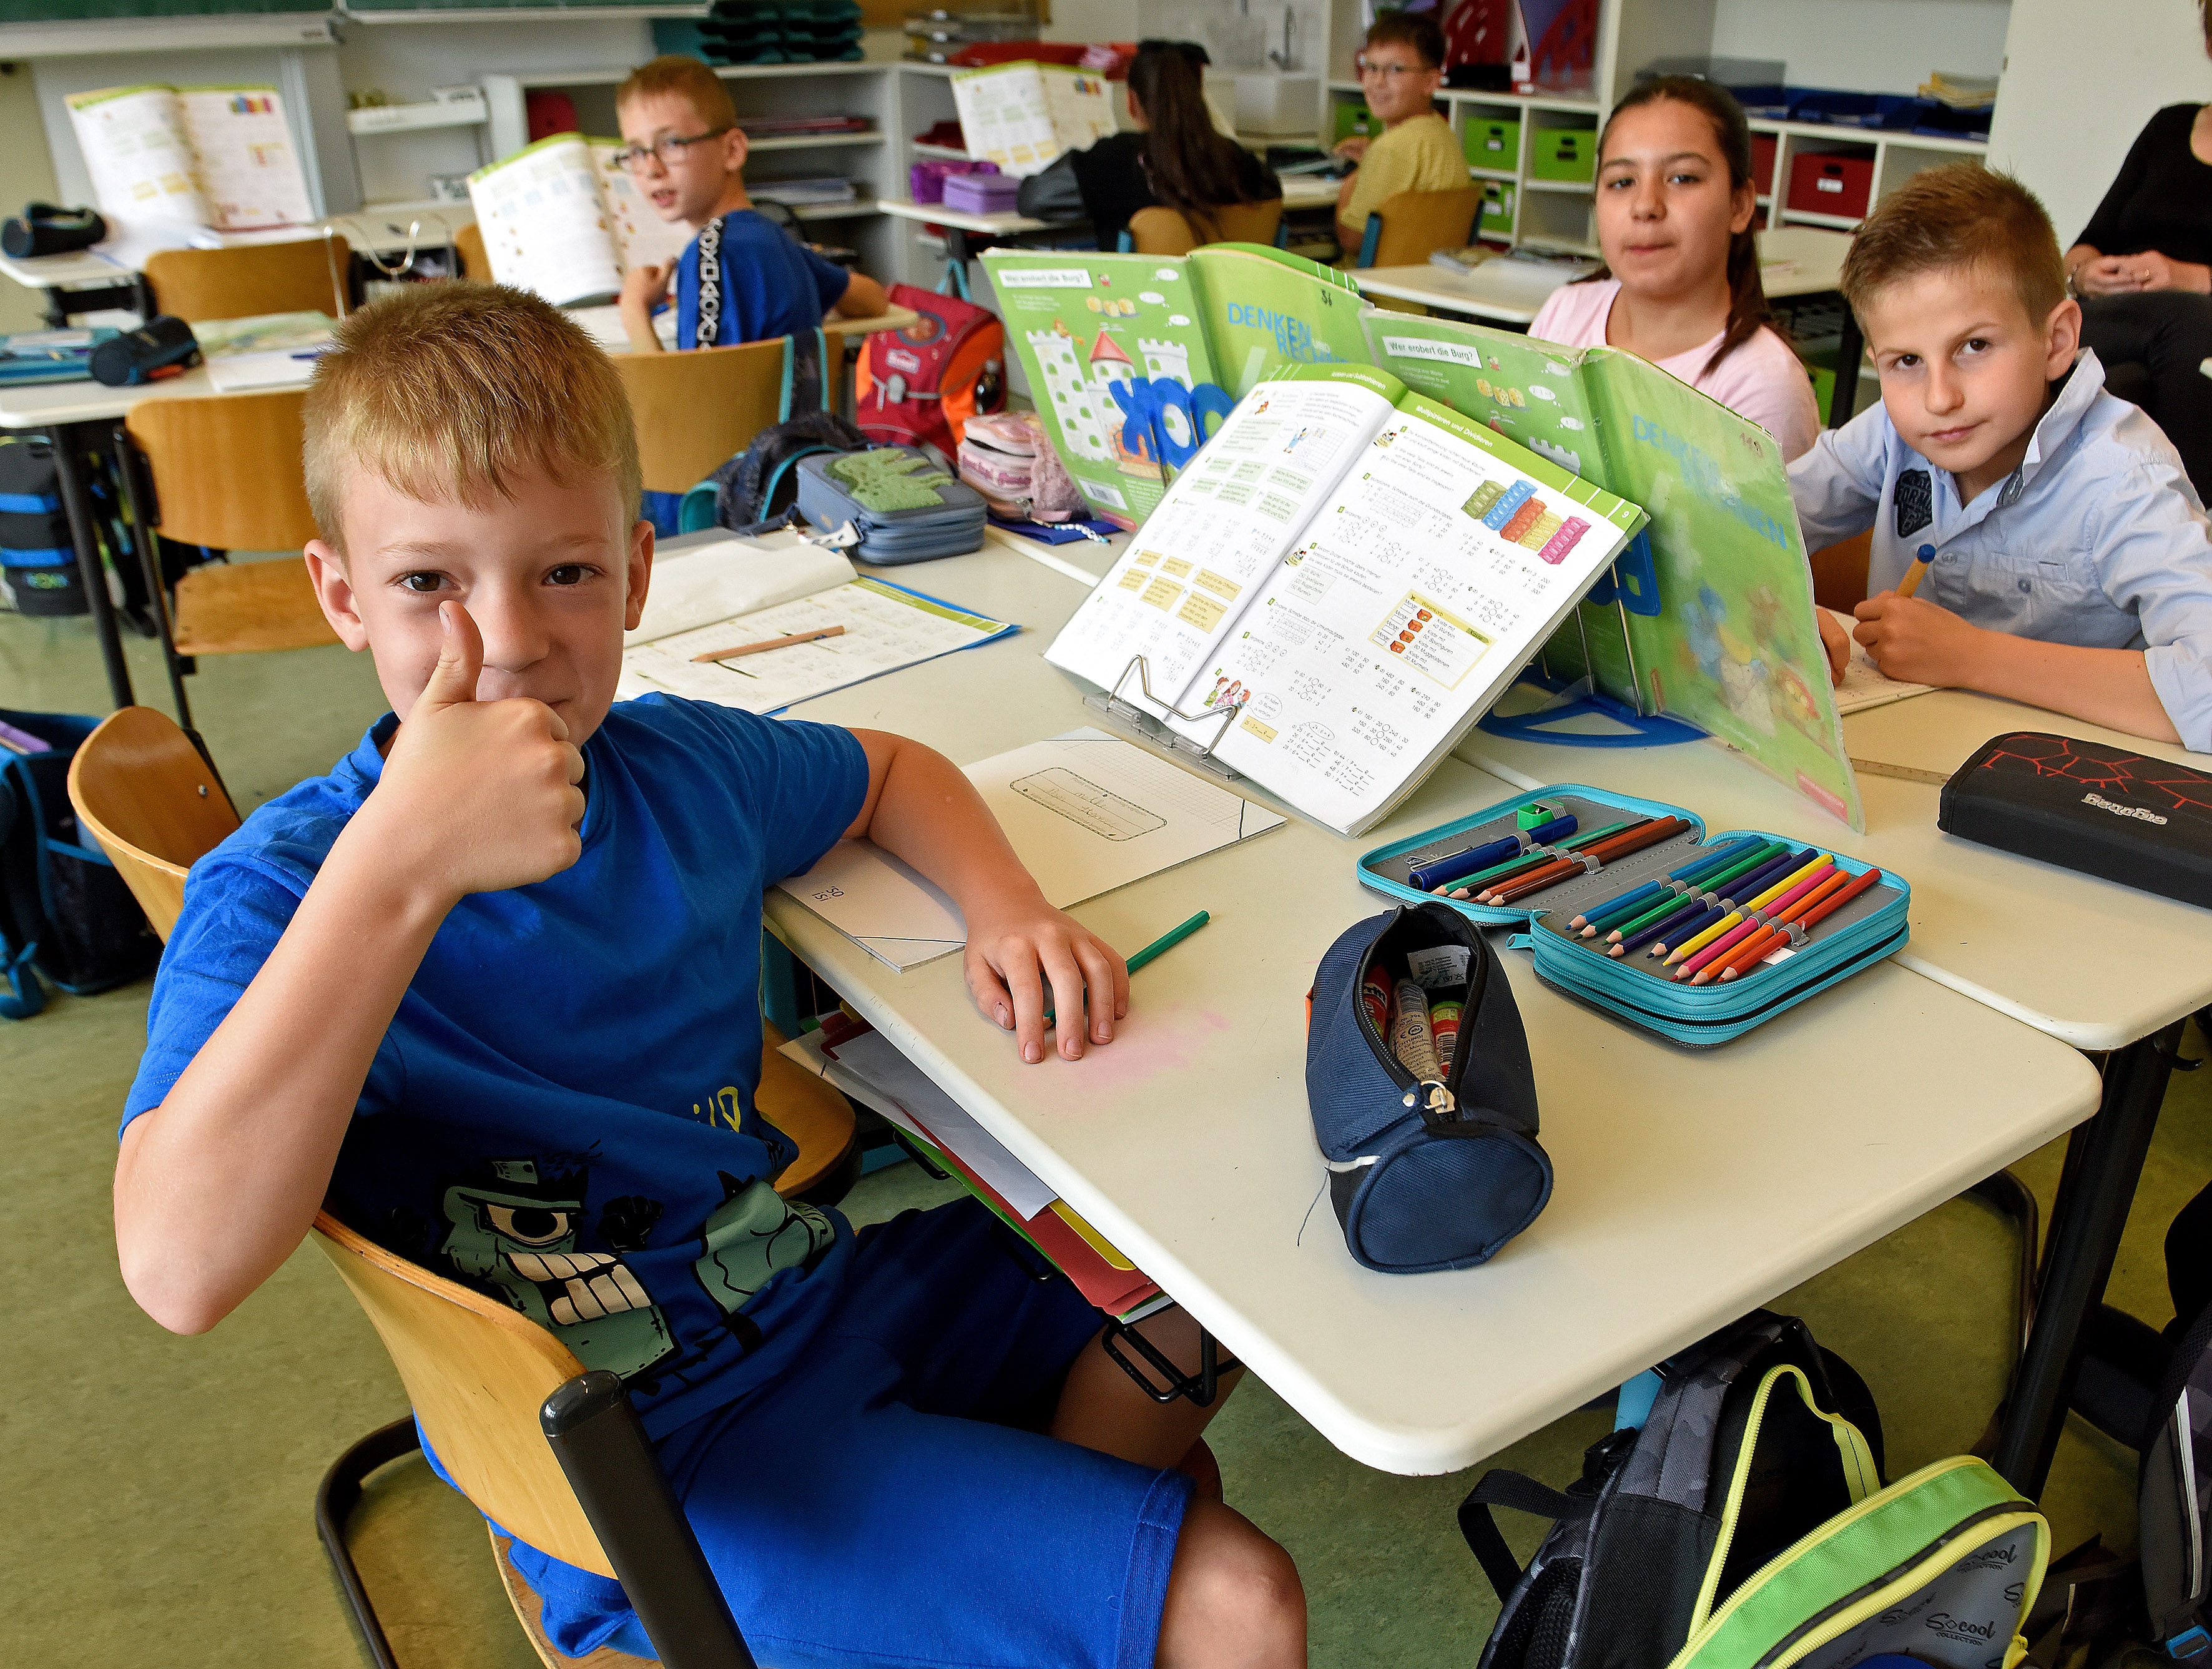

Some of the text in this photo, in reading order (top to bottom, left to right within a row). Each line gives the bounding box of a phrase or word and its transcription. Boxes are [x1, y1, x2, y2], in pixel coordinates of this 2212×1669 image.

[1227, 302, 1312, 348] DENKEN
[1390, 342, 1473, 362] Wer erobert die Burg?
[1451, 423, 1464, 432] und
[1463, 428, 1493, 447] Dividieren
[1403, 599, 1417, 609] Menge
[1394, 610, 1408, 619] Menge
[1385, 620, 1399, 631] Menge
[1422, 601, 1483, 641] Warenkorb Kasse
[1437, 619, 1447, 627] Kiste
[1375, 631, 1390, 641] Menge
[1427, 629, 1437, 638] Kiste
[1439, 627, 1455, 639] Würfeln
[1417, 640, 1428, 648] Kiste
[1429, 638, 1453, 654] Spielfiguren
[1408, 651, 1419, 659] Kiste
[1420, 648, 1449, 668] Muggelsteinen
[1410, 659, 1428, 672] Murmeln
[2080, 792, 2168, 825] ergobag
[1936, 1632, 1983, 1647] COLLECTION
